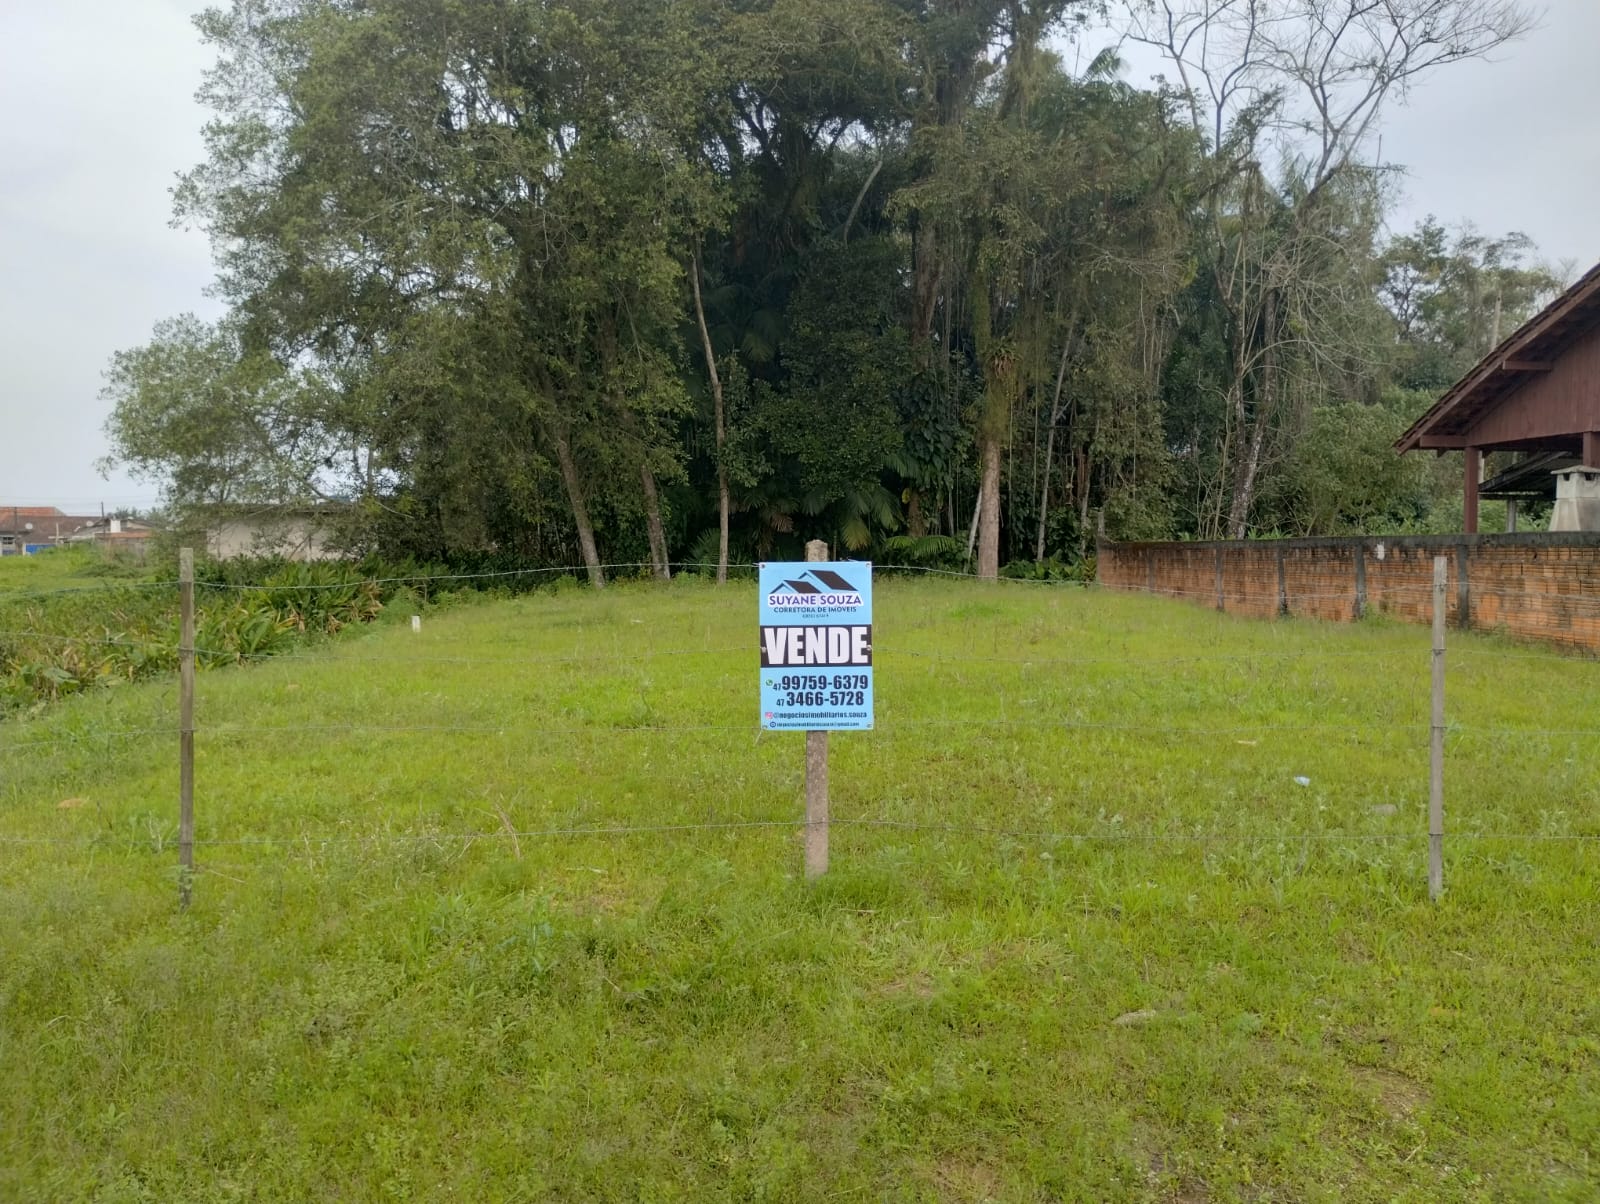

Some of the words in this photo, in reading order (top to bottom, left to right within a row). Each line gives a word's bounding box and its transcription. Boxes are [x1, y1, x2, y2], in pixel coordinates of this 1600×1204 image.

[769, 595, 816, 605] SUYANE
[820, 595, 861, 605] SOUZA
[764, 626, 869, 665] VENDE
[773, 683, 781, 691] 47
[782, 675, 868, 690] 99759-6379
[786, 691, 864, 706] 3466-5728
